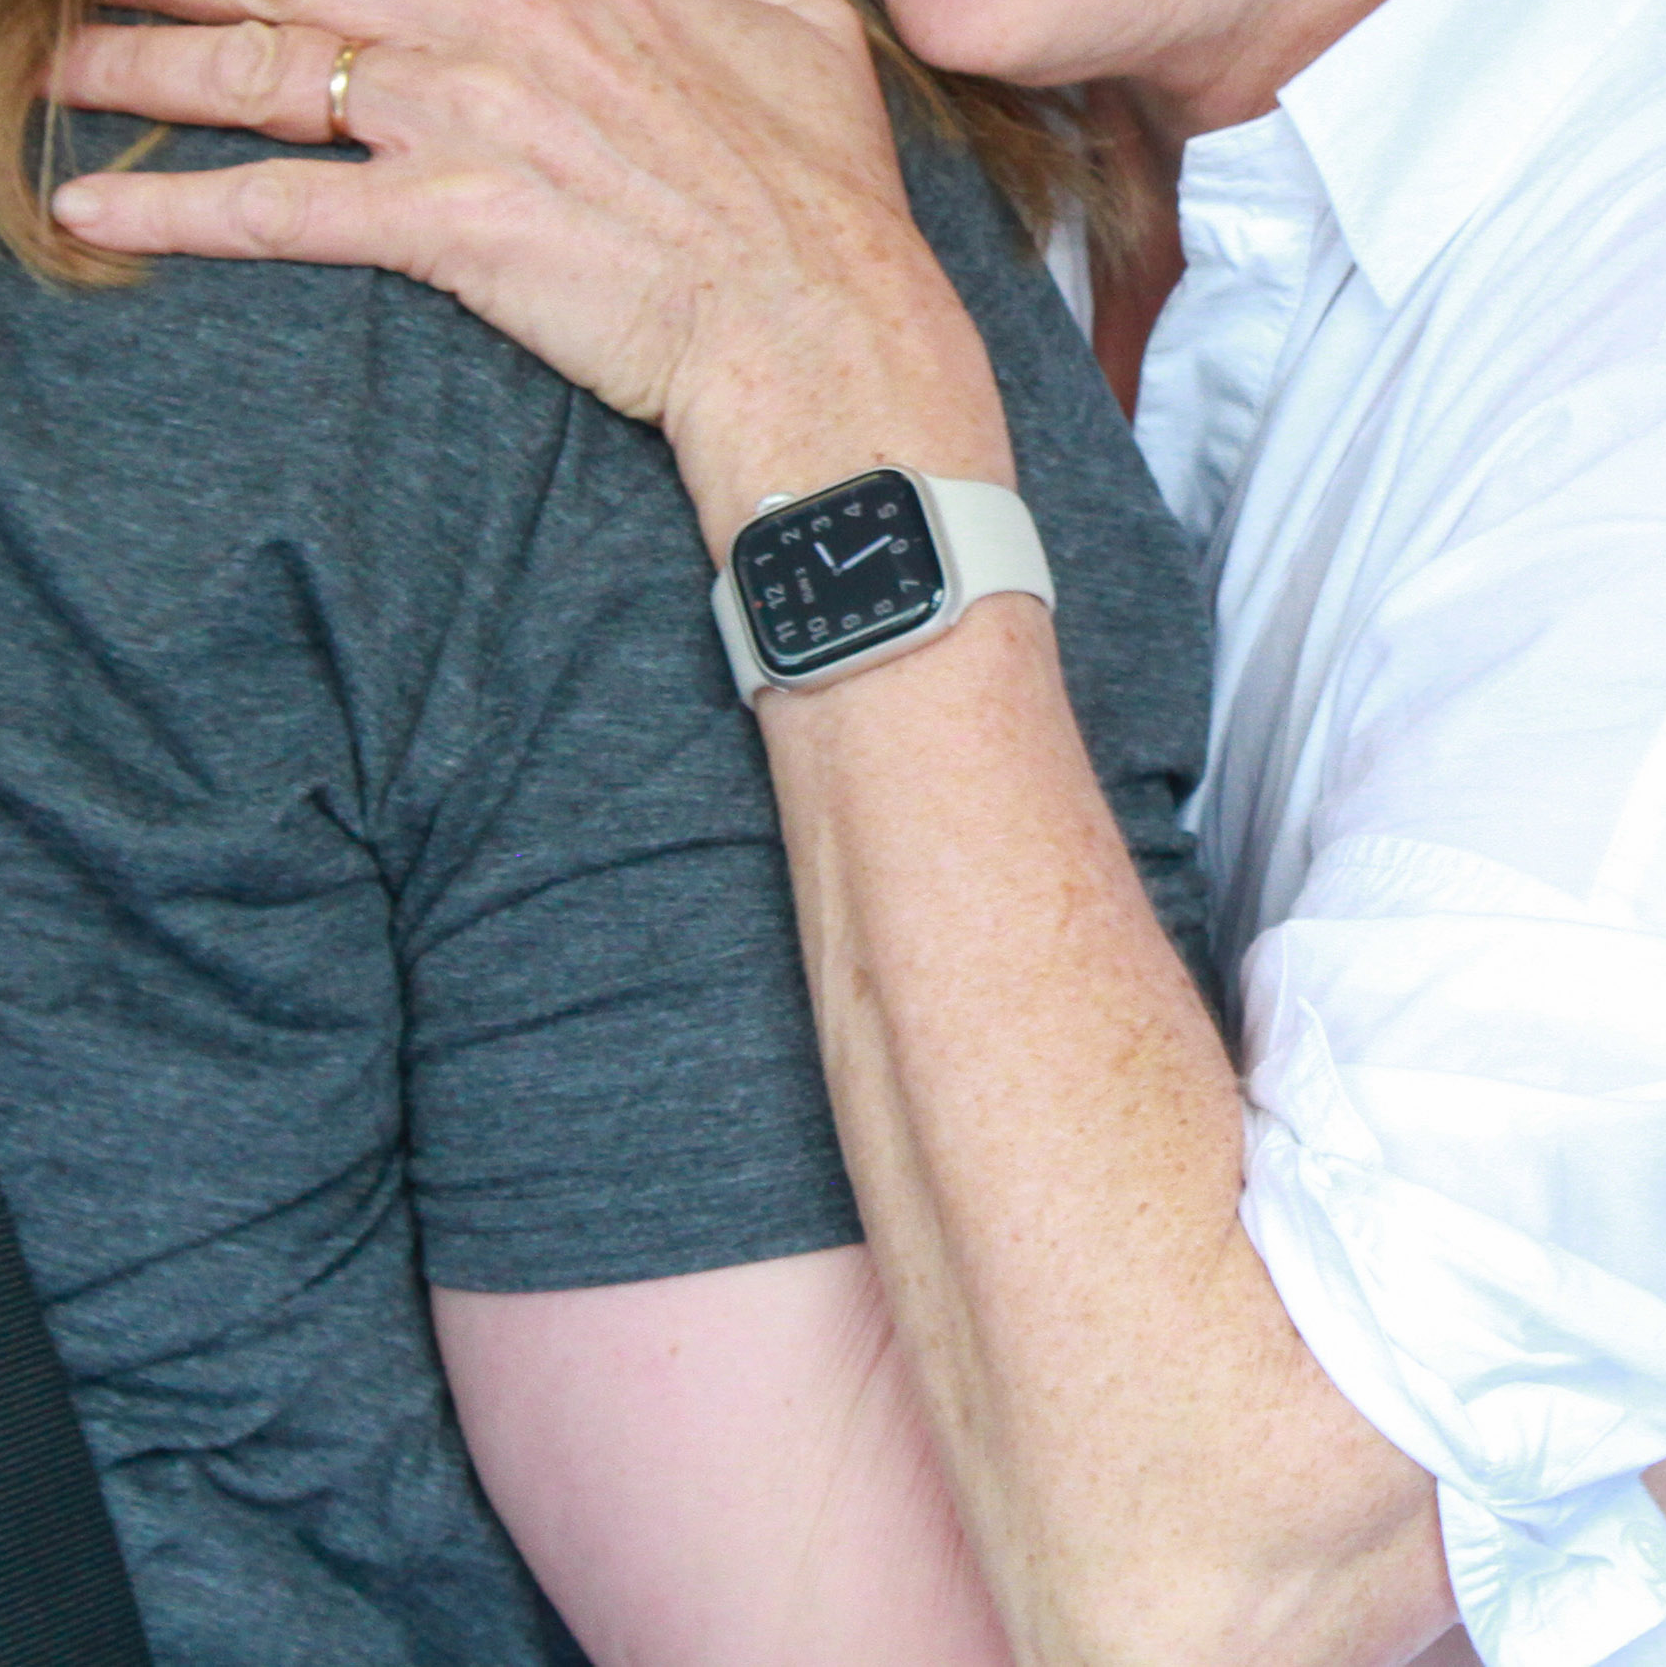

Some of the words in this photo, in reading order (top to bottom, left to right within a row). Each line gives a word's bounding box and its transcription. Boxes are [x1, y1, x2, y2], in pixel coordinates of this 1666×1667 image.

[844, 503, 861, 516] 4
[812, 516, 831, 532] 3
[781, 529, 801, 543] 2
[890, 539, 909, 554] 6
[755, 554, 772, 566] 1
[900, 580, 920, 592] 7
[765, 584, 785, 609] 12
[874, 599, 893, 615] 8
[808, 616, 828, 642] 10
[842, 614, 861, 630] 9
[776, 621, 796, 642] 11
